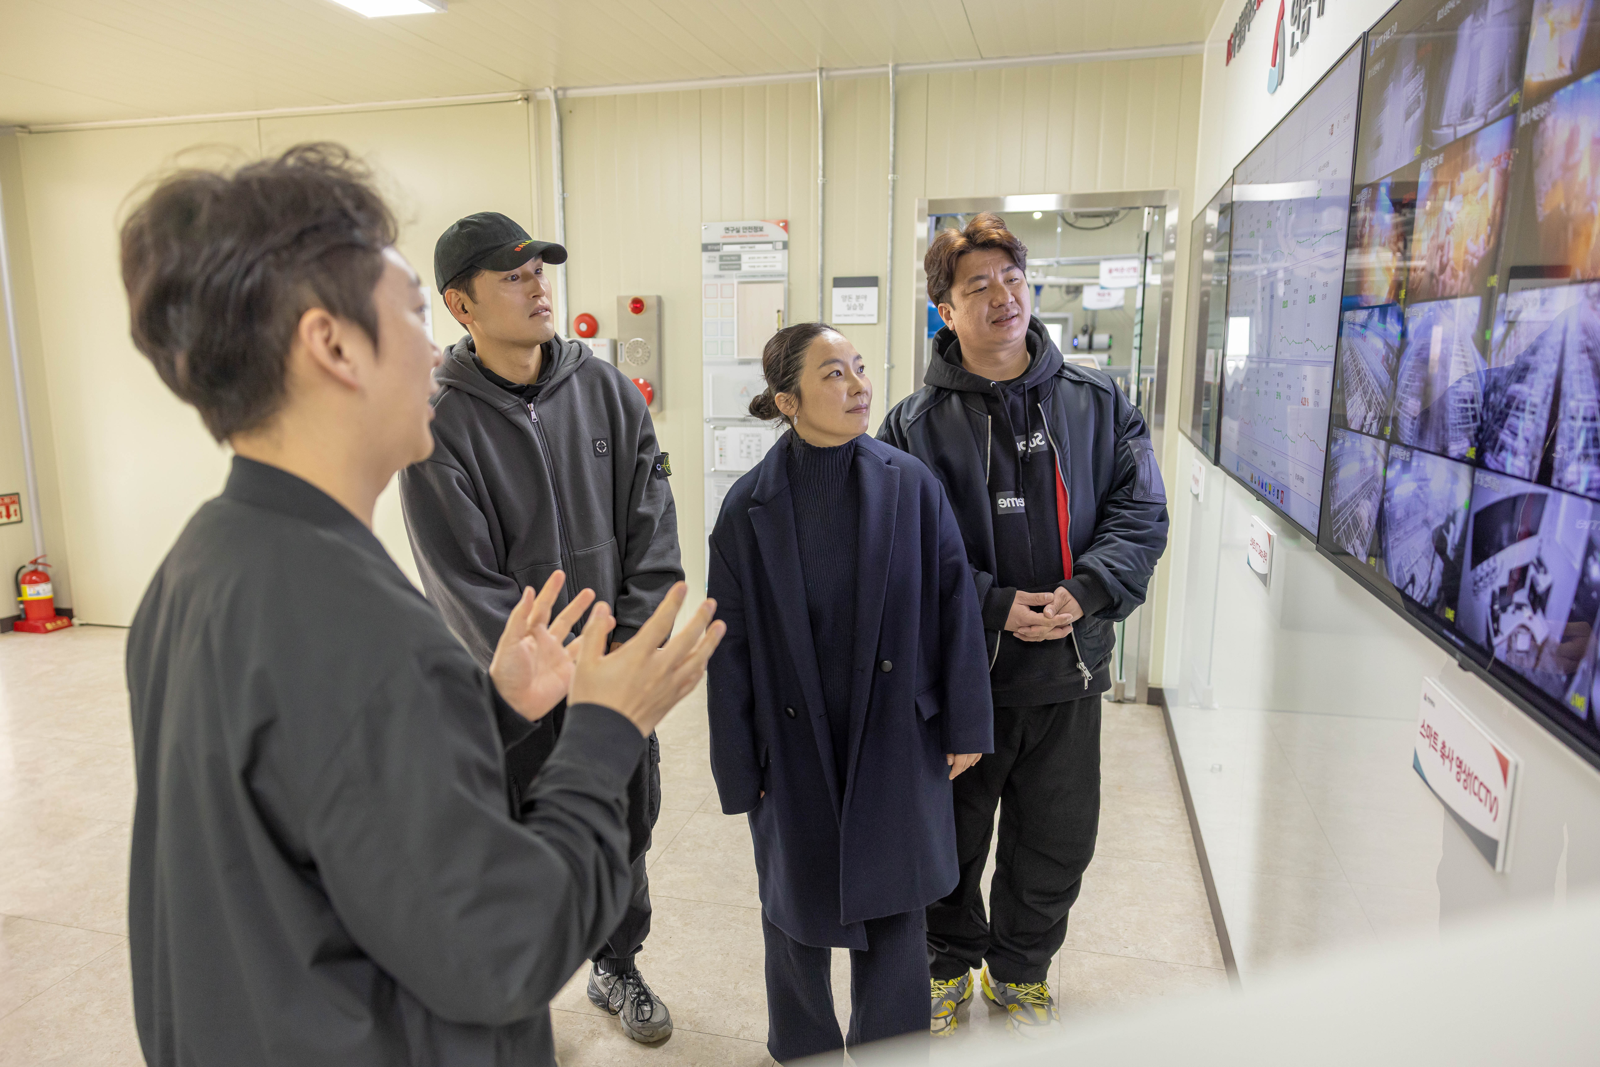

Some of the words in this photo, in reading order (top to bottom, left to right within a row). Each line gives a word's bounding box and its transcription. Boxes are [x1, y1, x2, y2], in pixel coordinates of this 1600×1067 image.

[1419, 719, 1440, 753] 스마트
[1439, 740, 1455, 772] 축사
[1455, 756, 1500, 822] 영상(CCTV)
